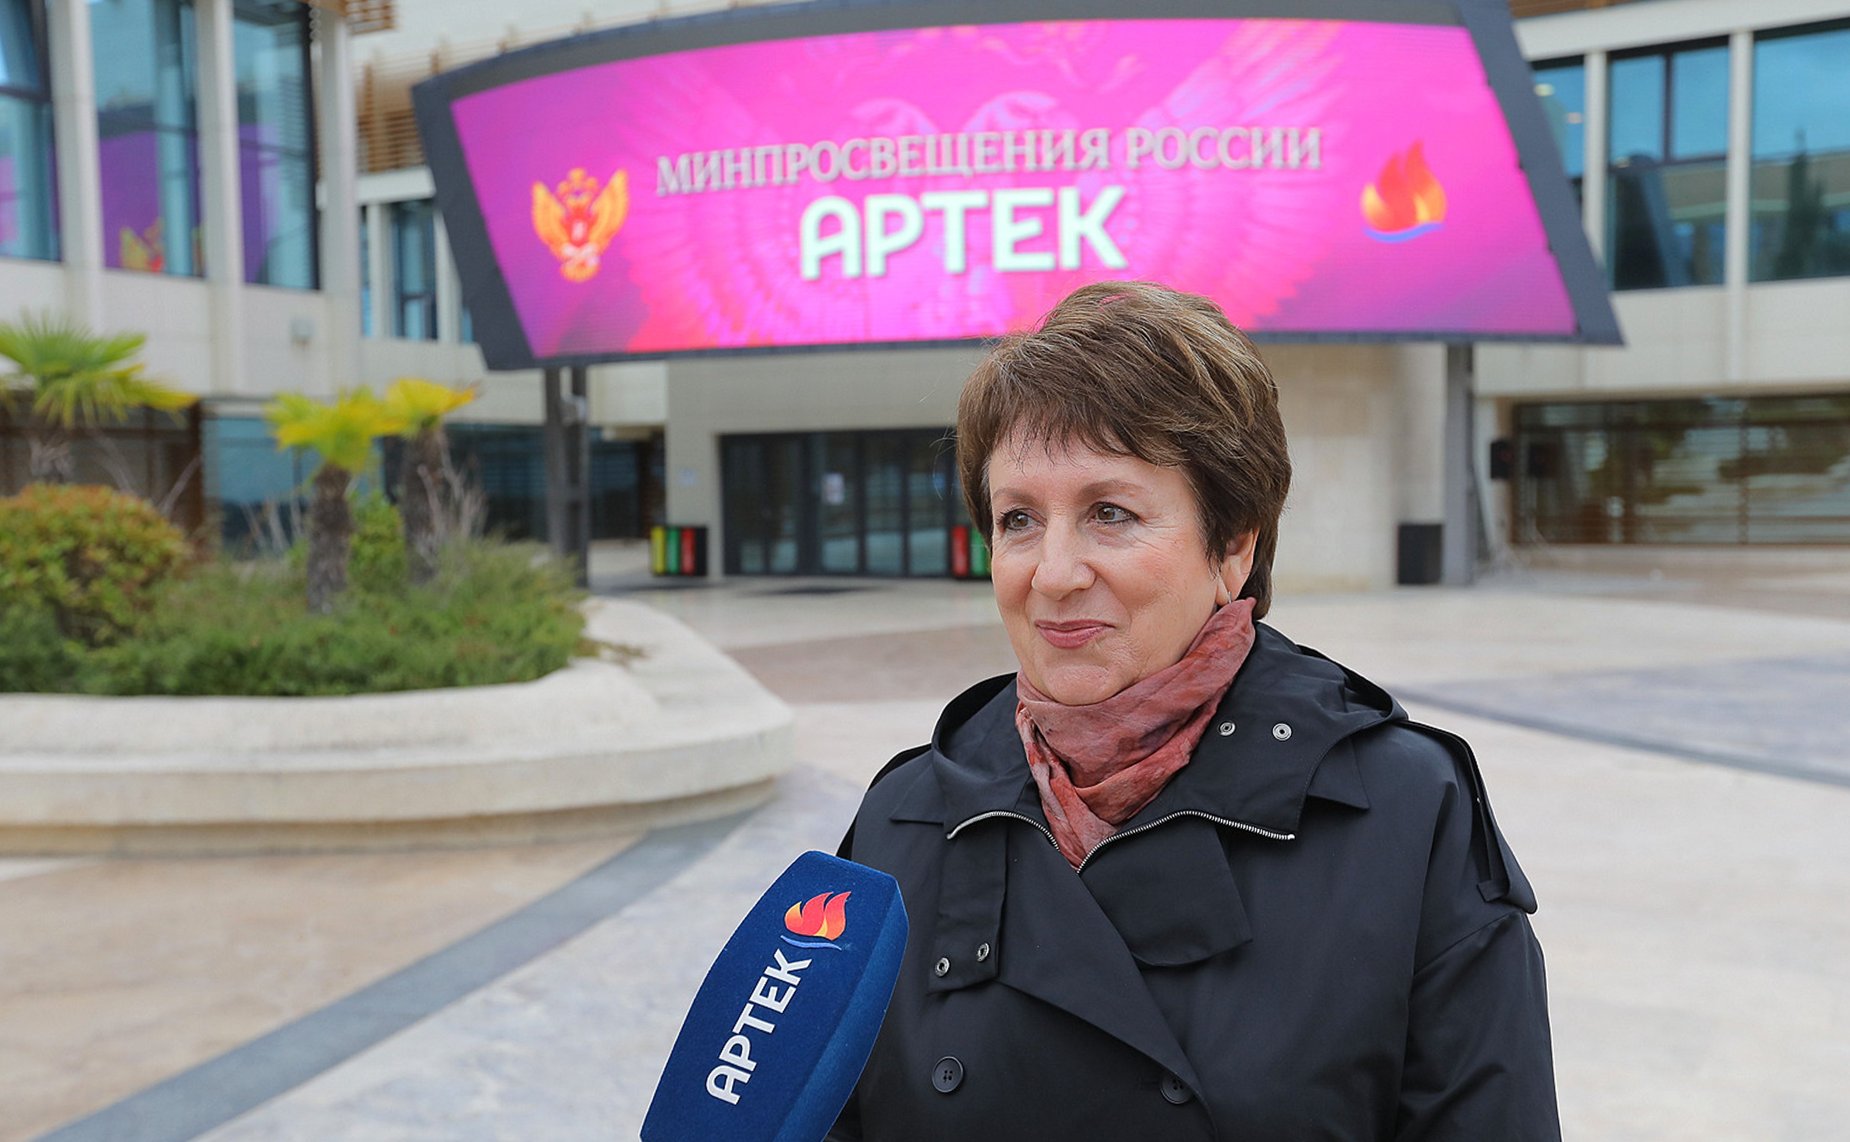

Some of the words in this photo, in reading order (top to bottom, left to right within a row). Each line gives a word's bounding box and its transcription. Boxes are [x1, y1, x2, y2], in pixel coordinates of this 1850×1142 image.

[656, 127, 1111, 197] МИНПРОСВЕЩЕНИЯ
[1125, 126, 1322, 170] РОССИИ
[800, 184, 1128, 281] АРТЕК
[705, 948, 813, 1106] АРТЕК
